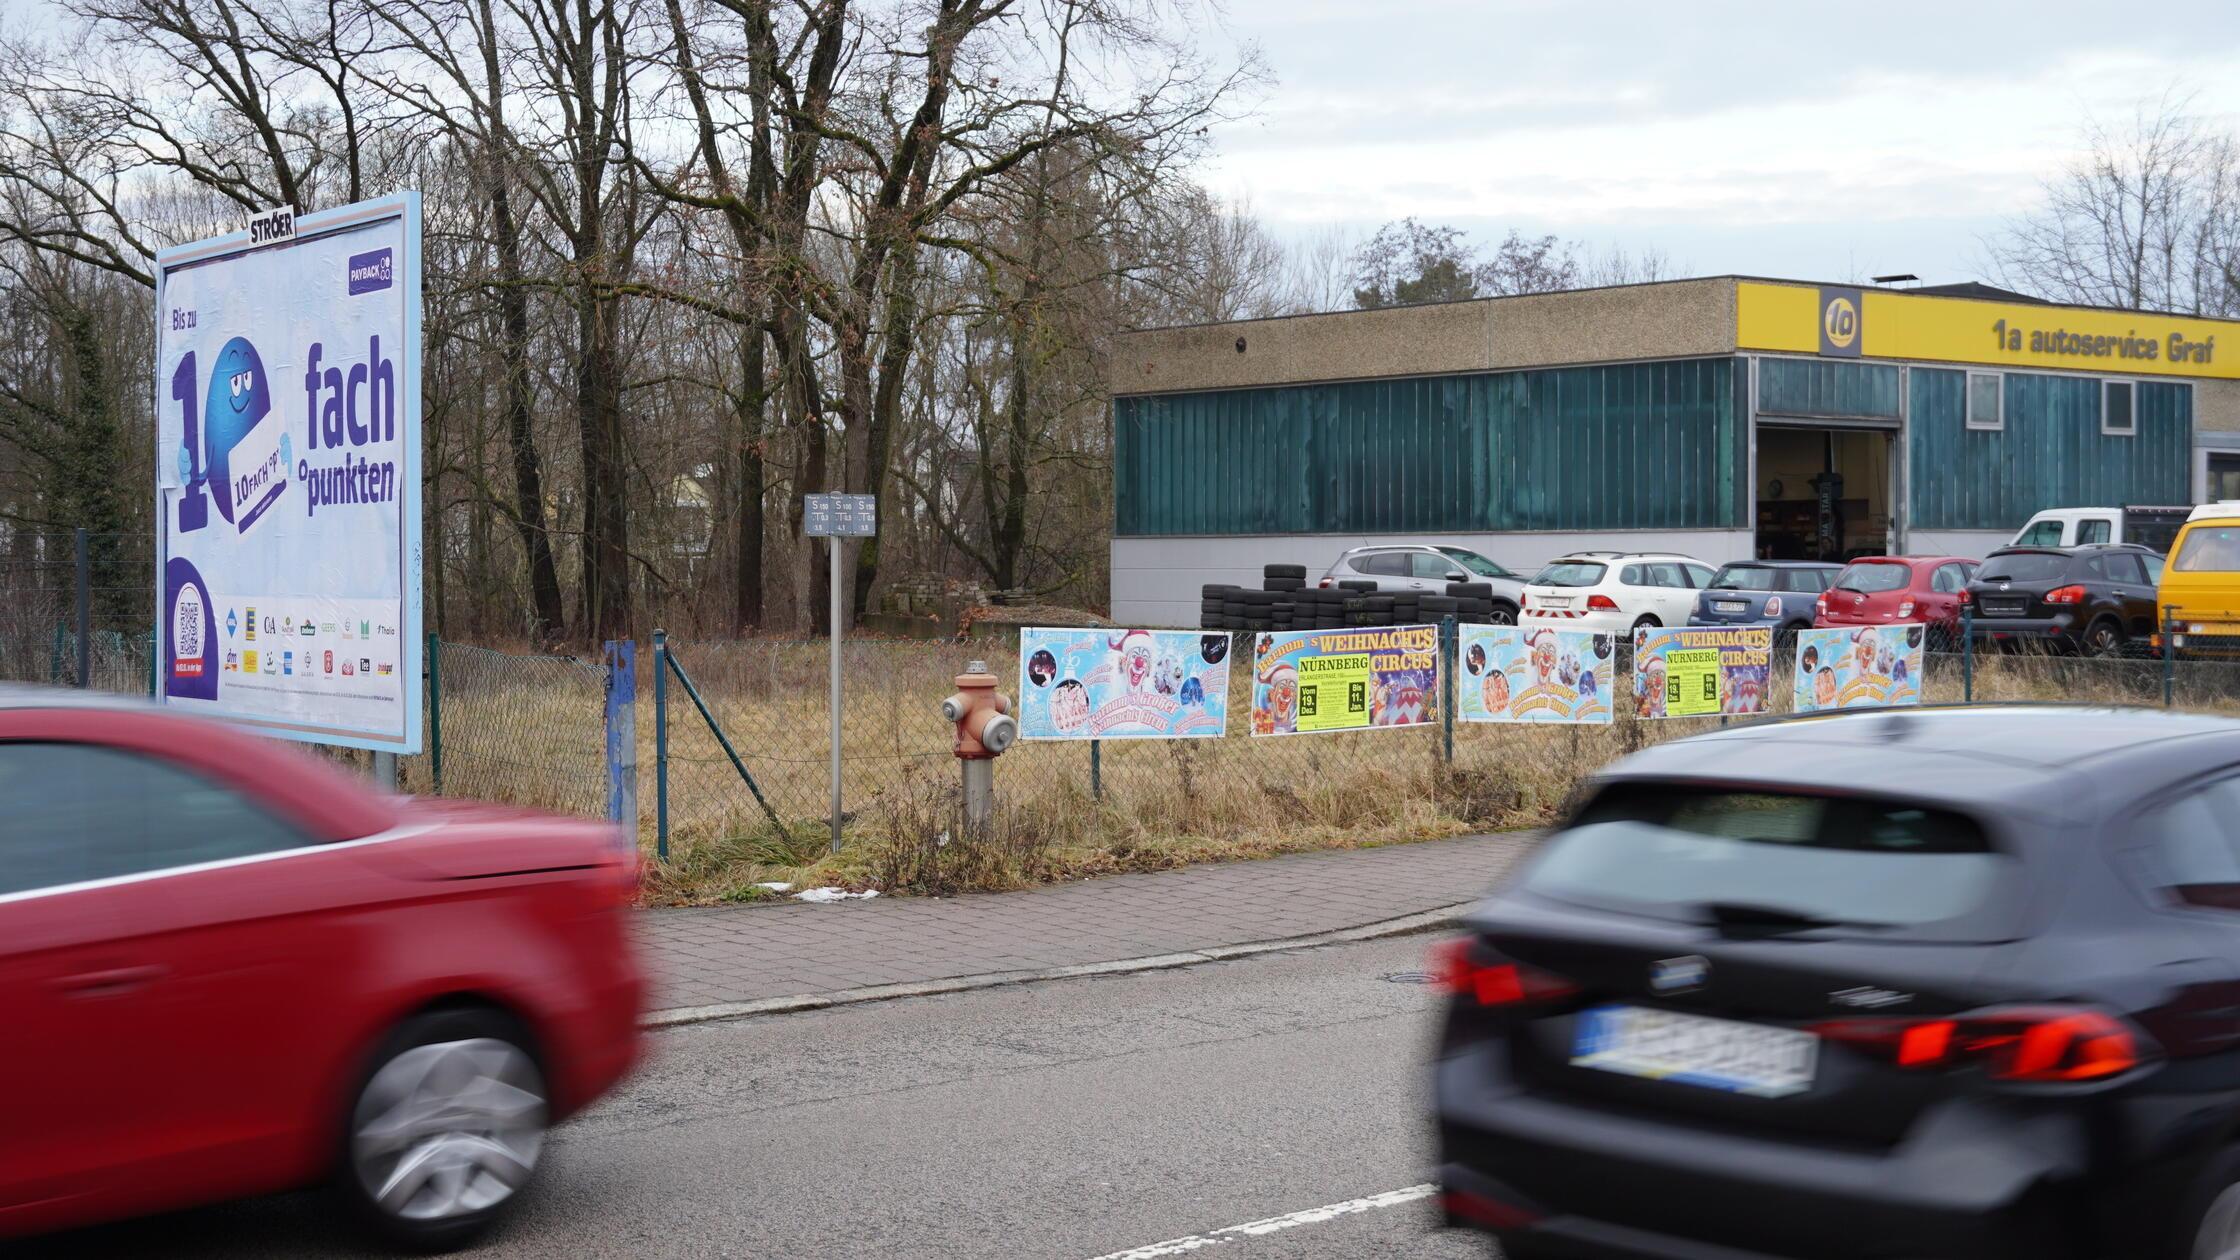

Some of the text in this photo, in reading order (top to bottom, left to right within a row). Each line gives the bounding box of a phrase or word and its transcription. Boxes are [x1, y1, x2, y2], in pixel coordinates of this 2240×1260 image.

[250, 211, 293, 244] STRÖER
[351, 265, 380, 283] PAYBACK
[173, 308, 197, 331] Bis zu
[1993, 319, 2214, 364] 1a autoservice Graf
[305, 334, 395, 450] fach
[1318, 628, 1435, 653] WEIHNACHTS
[1680, 630, 1770, 648] WEIHNACHTS
[1299, 656, 1368, 673] NÜRNBERG
[1370, 653, 1433, 672] CIRCUS
[1666, 650, 1718, 665] NÜRNBERG
[1720, 651, 1768, 667] CIRCUS
[1351, 692, 1363, 702] 11.
[1352, 684, 1362, 692] Bis
[1301, 696, 1315, 706] 19.
[1350, 702, 1363, 711] Jan.
